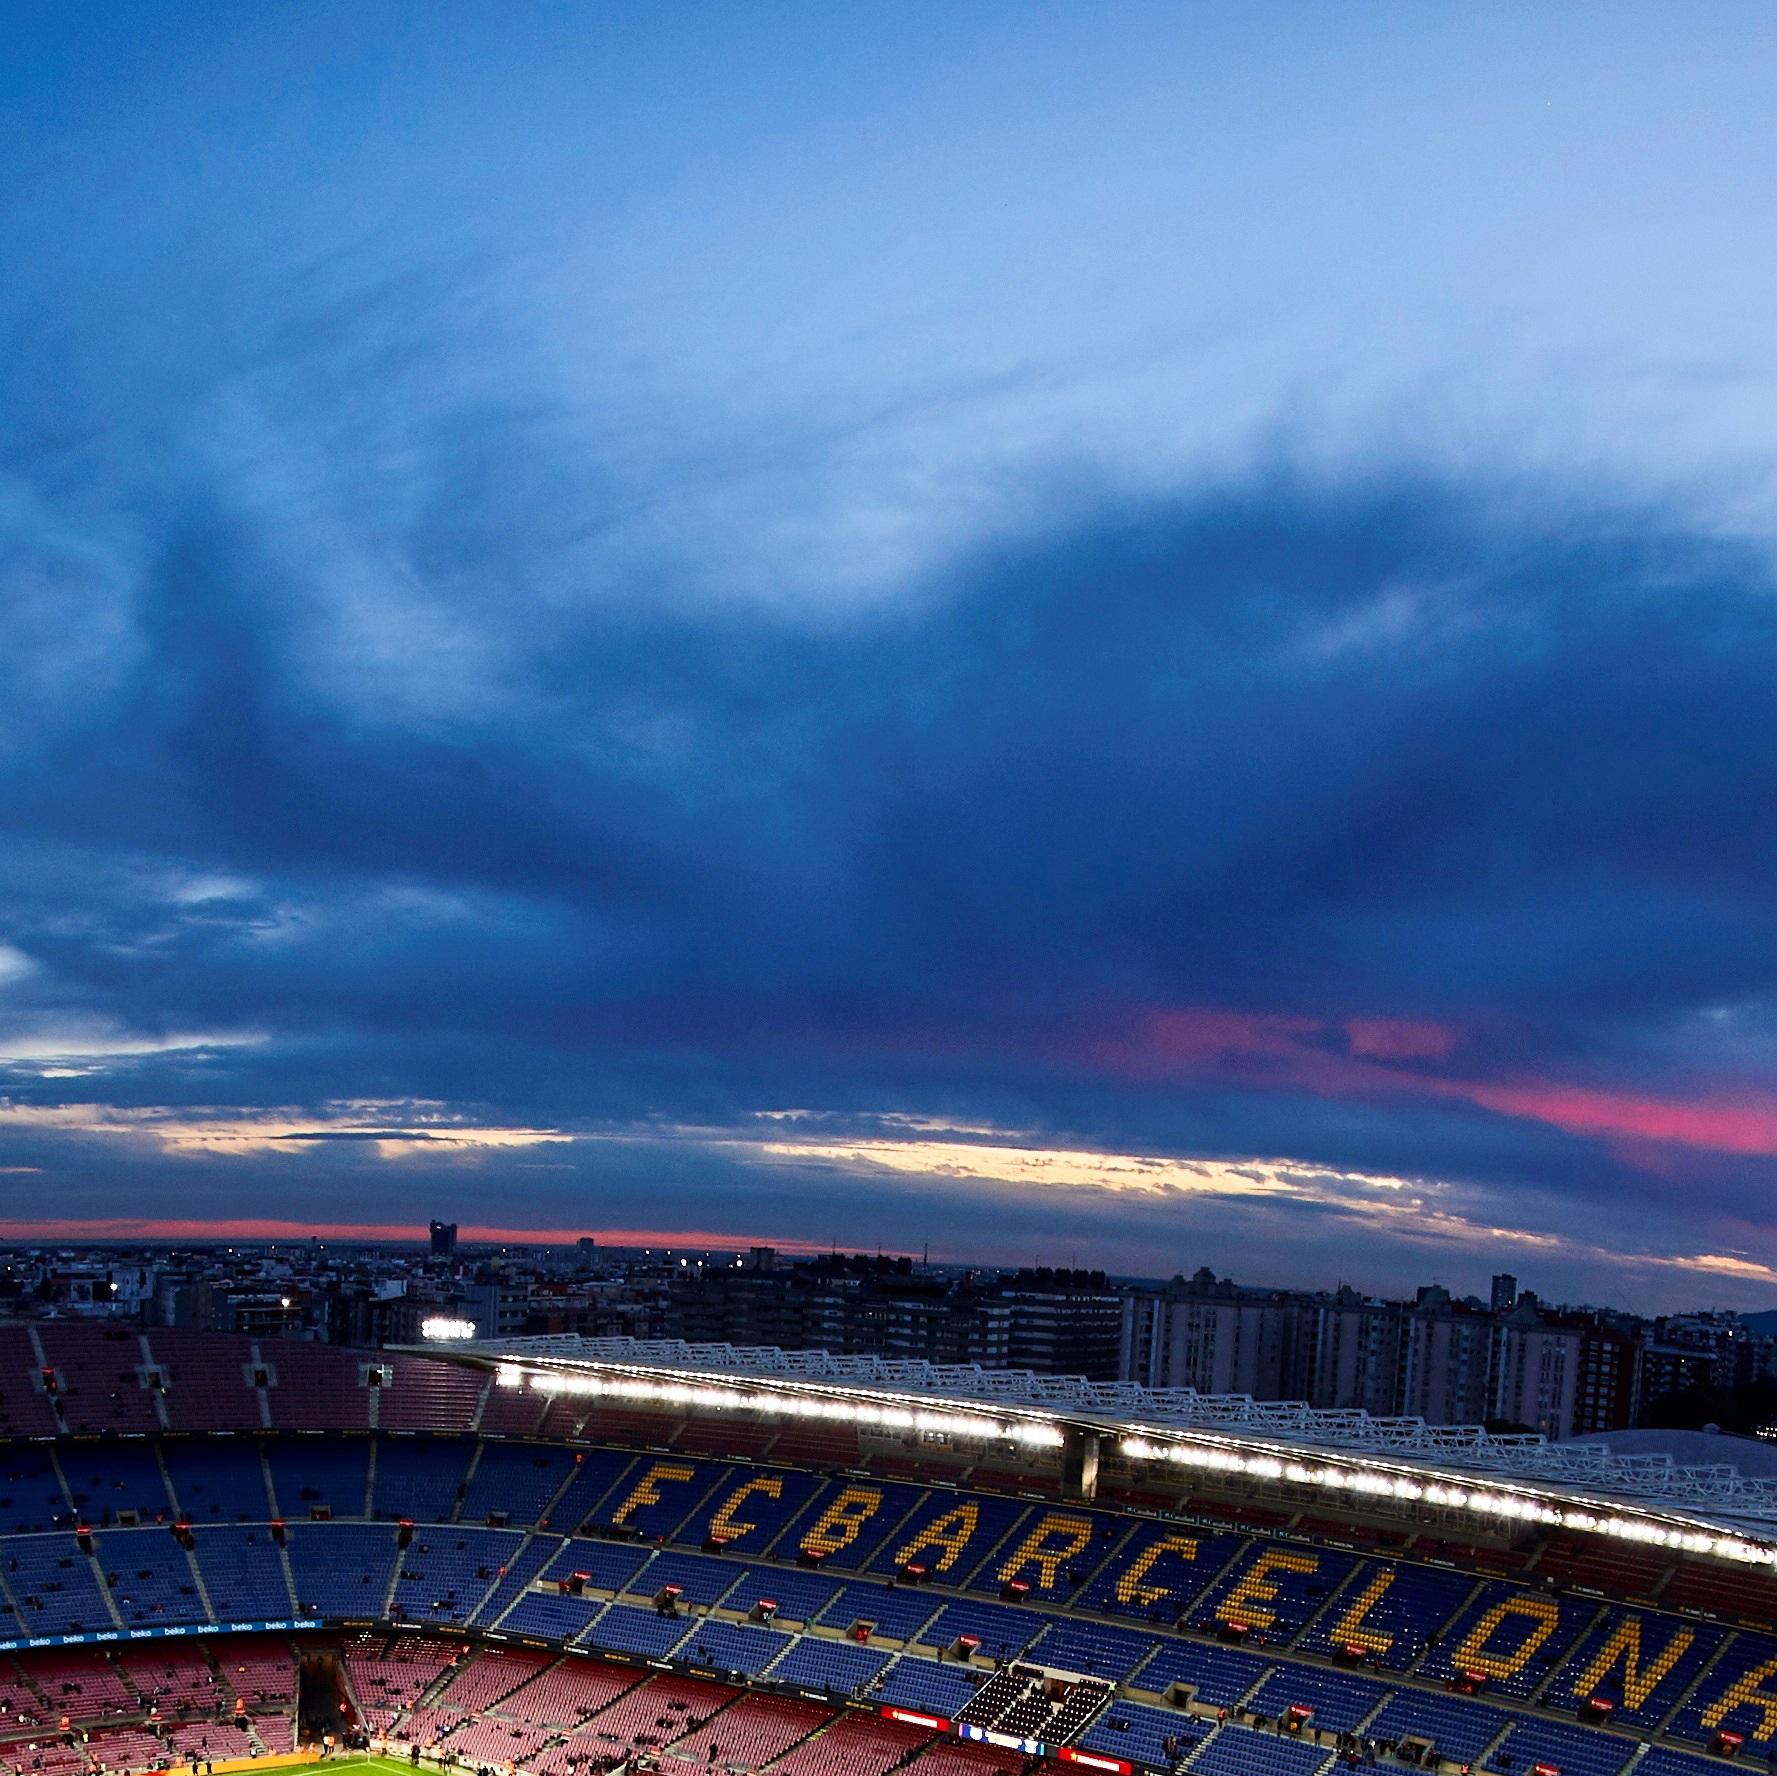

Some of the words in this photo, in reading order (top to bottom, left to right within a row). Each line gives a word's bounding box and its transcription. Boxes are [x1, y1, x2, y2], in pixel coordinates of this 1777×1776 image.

[30, 1638, 50, 1646] beko
[64, 1635, 84, 1643] beko
[97, 1632, 118, 1640] beko
[130, 1630, 152, 1638] beko
[164, 1627, 186, 1635] beko
[198, 1625, 218, 1633] beko
[232, 1623, 252, 1631] beko
[266, 1622, 286, 1630] beko
[294, 1620, 315, 1628] beko
